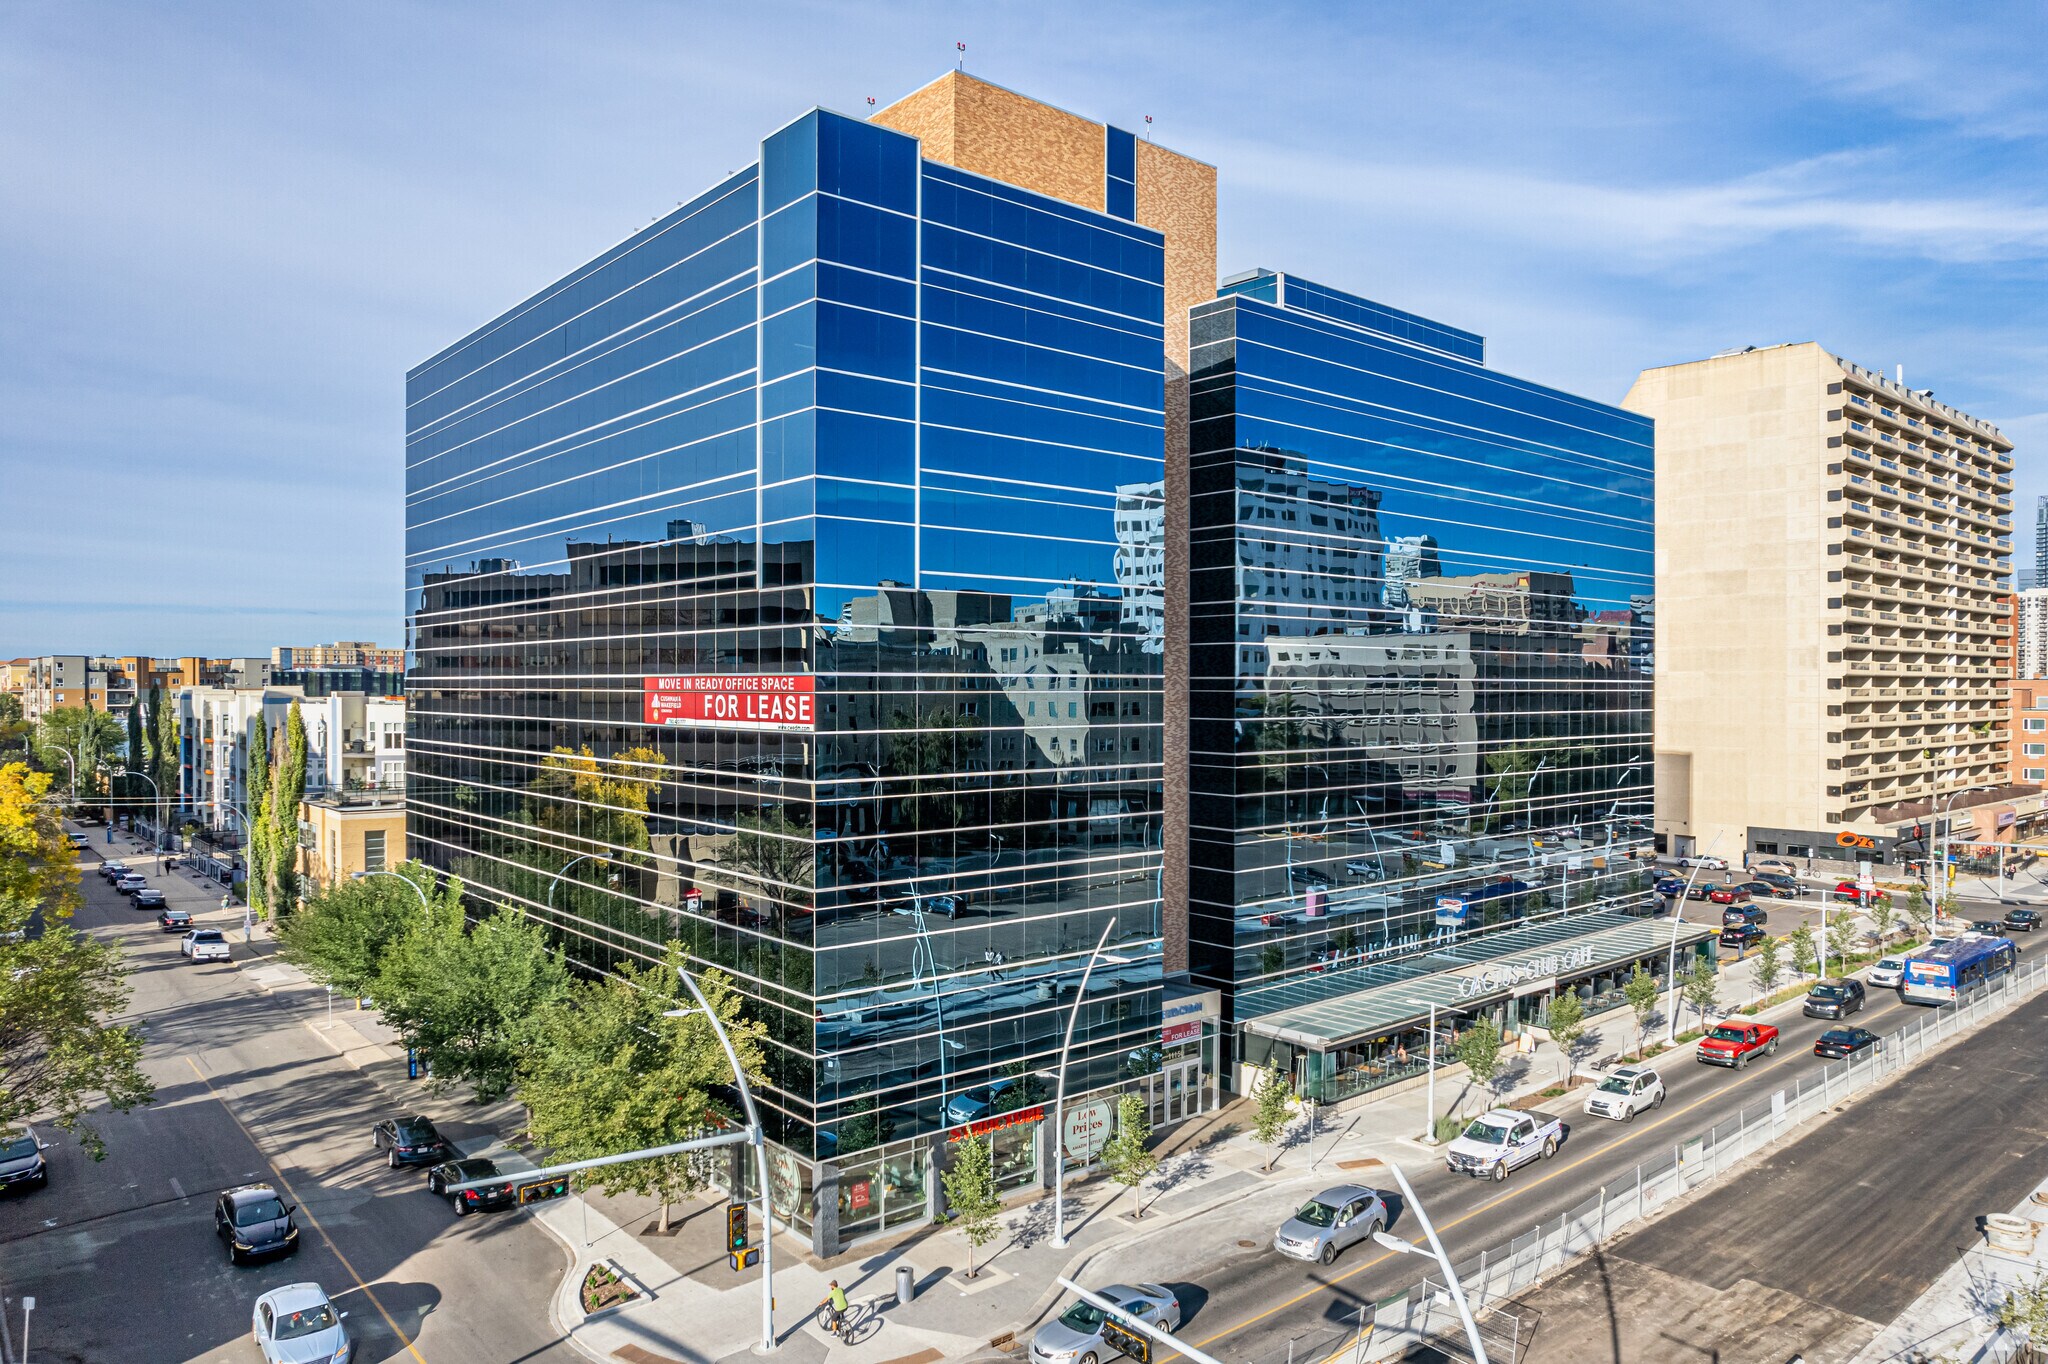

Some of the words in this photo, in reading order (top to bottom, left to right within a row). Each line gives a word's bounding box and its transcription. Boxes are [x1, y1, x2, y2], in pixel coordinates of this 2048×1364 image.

[658, 678, 681, 690] MOVE
[683, 678, 692, 690] IN
[695, 678, 723, 690] READY
[725, 678, 759, 690] OFFICE
[761, 678, 795, 691] SPACE
[704, 695, 739, 718] FOR
[746, 695, 811, 721] LEASE
[1460, 965, 1519, 998] CACTUS
[1525, 955, 1558, 980] CLUB
[1563, 946, 1594, 970] CAFE
[1183, 1028, 1201, 1038] LEASE
[947, 1106, 1045, 1143] STRUCTUBE
